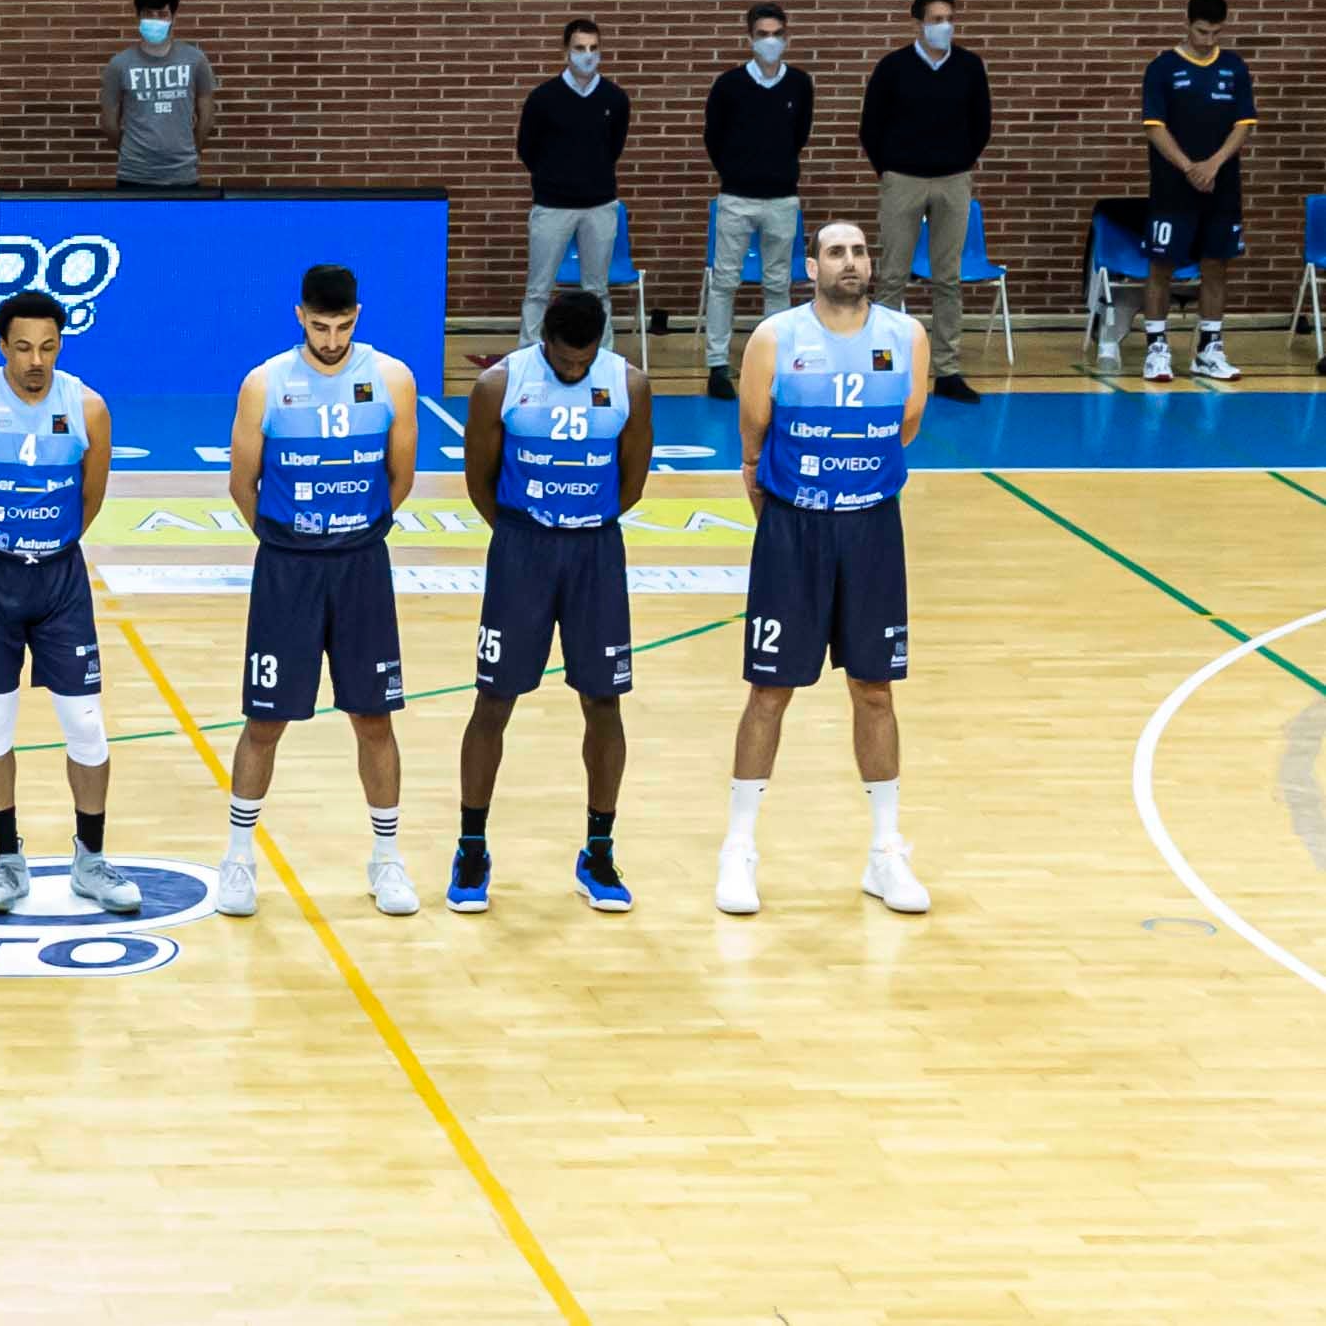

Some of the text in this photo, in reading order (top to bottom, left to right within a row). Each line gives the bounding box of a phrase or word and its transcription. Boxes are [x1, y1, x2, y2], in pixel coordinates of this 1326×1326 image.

[130, 65, 190, 90] FITCH
[832, 373, 864, 407] 12
[316, 403, 350, 439] 13
[550, 406, 589, 441] 25
[790, 421, 832, 438] Liber
[19, 433, 37, 466] 4
[280, 451, 321, 466] Liber
[822, 456, 881, 471] OVIEDO
[315, 480, 369, 495] OVIEDO
[545, 481, 599, 495] OVIEDO
[7, 506, 61, 520] OVIEDO
[477, 625, 501, 663] 25
[752, 616, 782, 653] 12
[250, 652, 278, 689] 13
